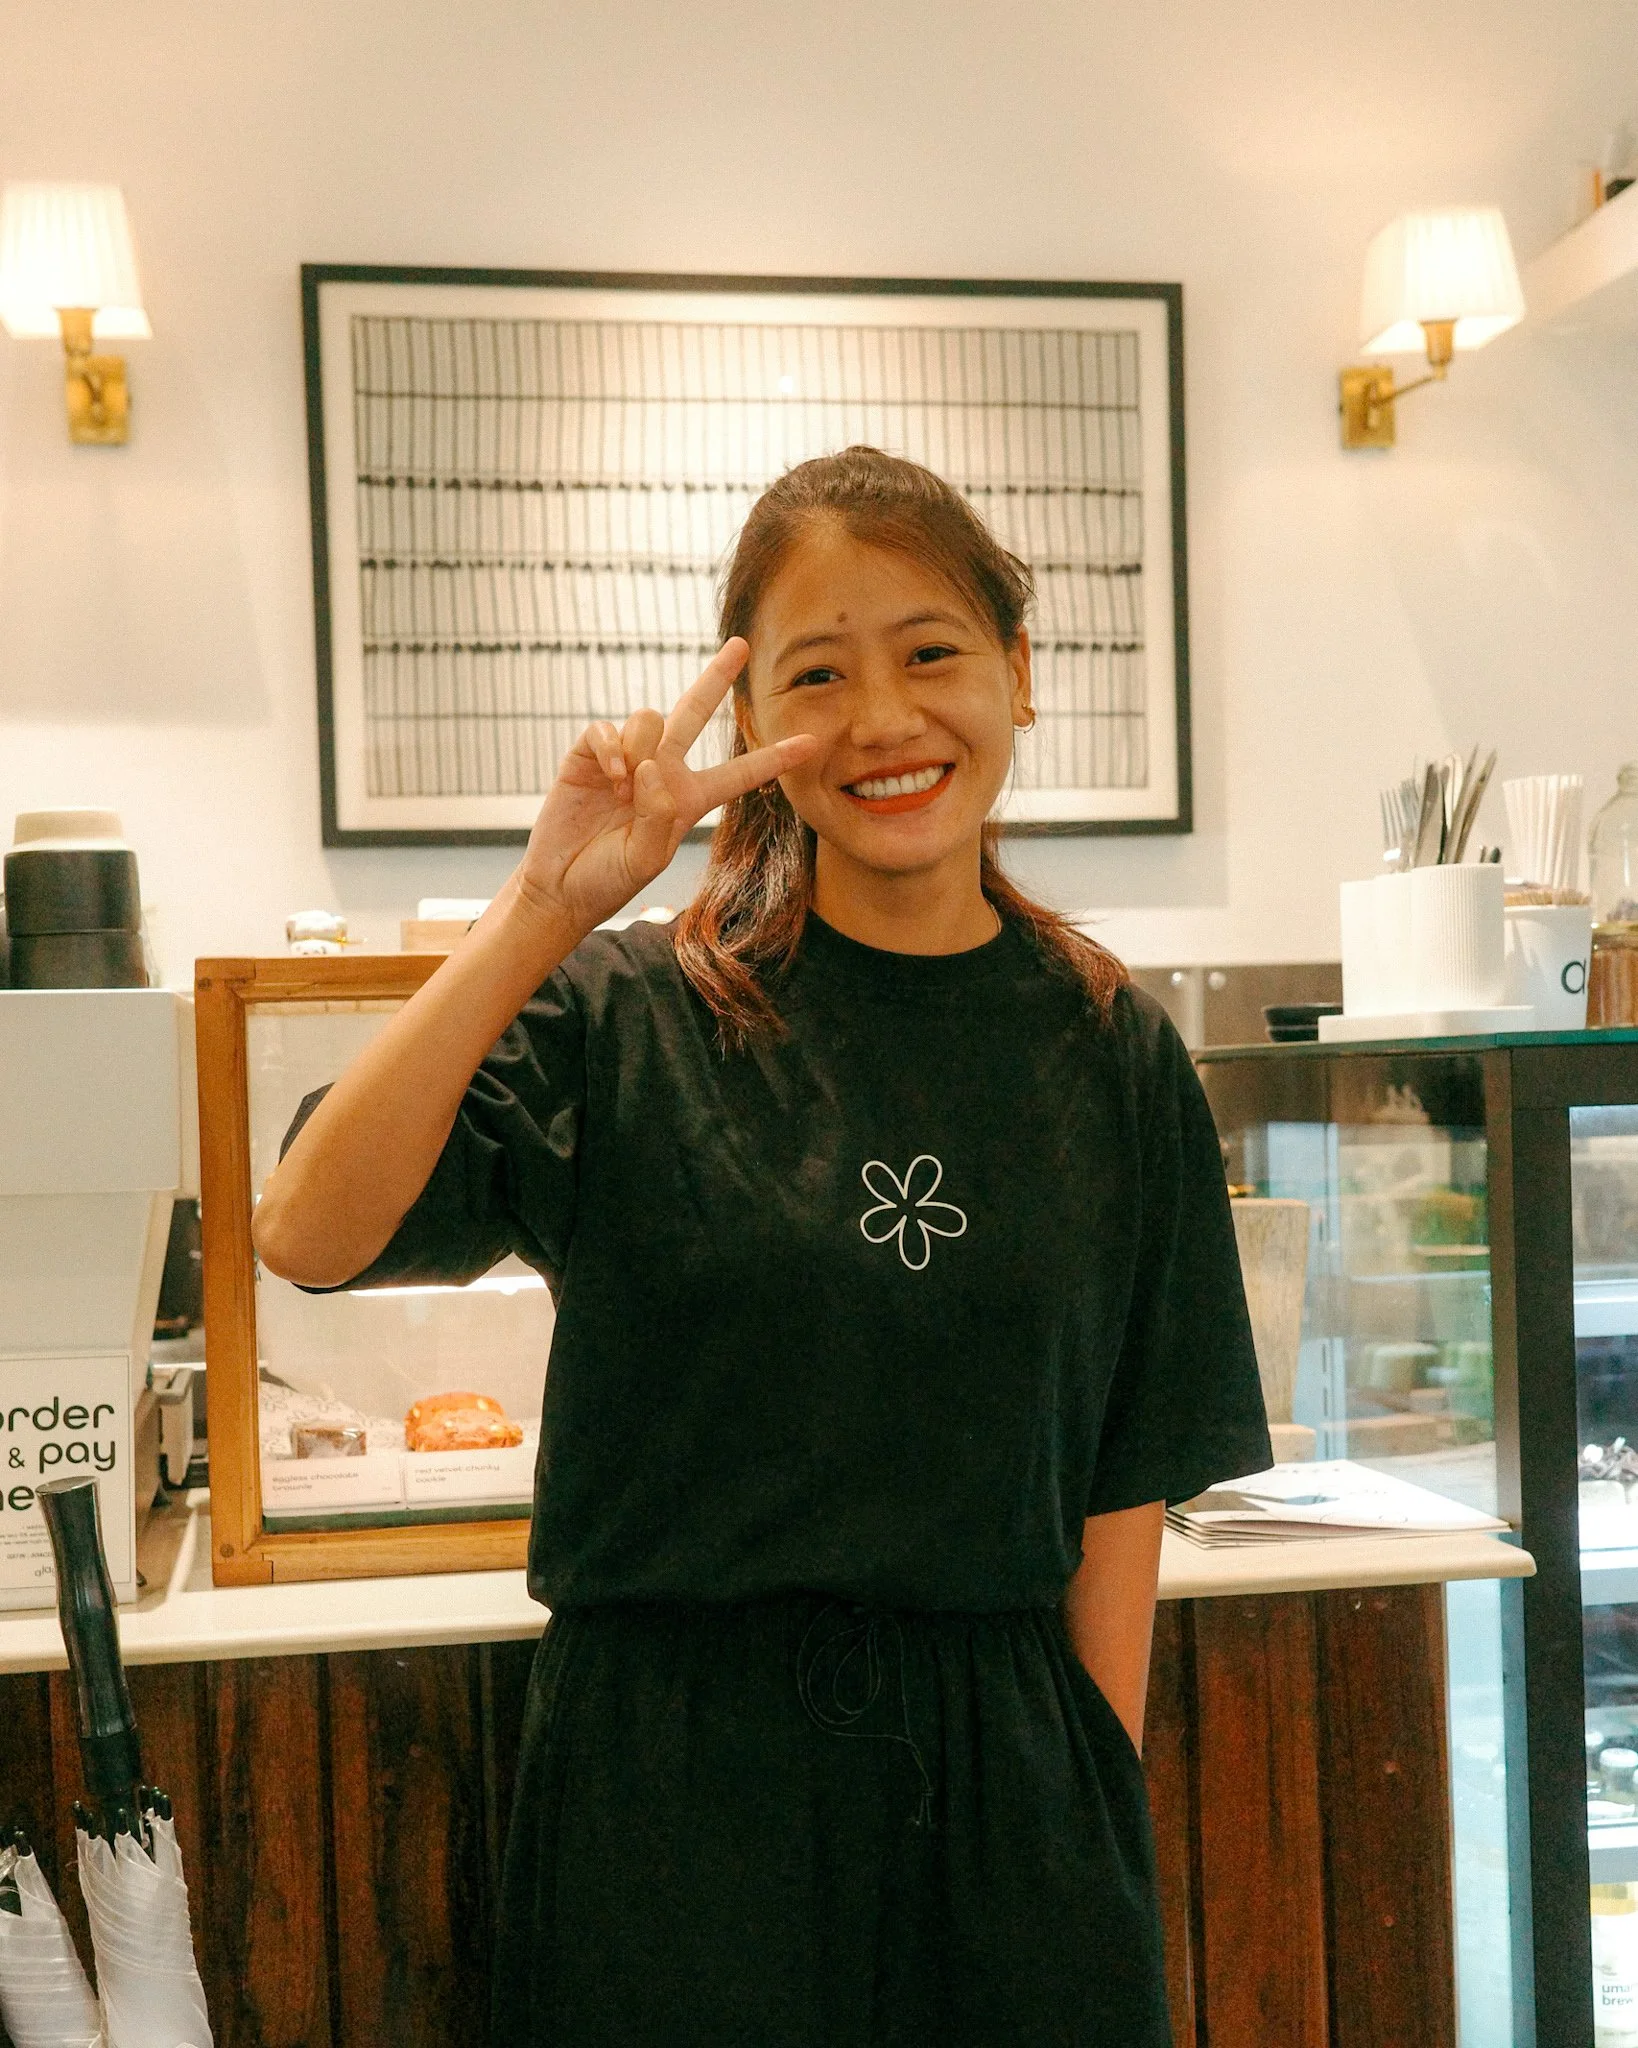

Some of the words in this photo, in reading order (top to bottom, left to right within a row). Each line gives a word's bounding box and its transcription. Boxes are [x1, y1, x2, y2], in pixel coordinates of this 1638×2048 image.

[0, 1396, 115, 1433] rder
[8, 1447, 25, 1469] &
[39, 1440, 116, 1474] pay
[434, 1465, 462, 1473] velvet
[465, 1463, 500, 1472] chunky
[272, 1472, 308, 1484] eggless
[310, 1470, 359, 1481] chocolate
[415, 1475, 447, 1484] cookie
[272, 1483, 313, 1492] brownie
